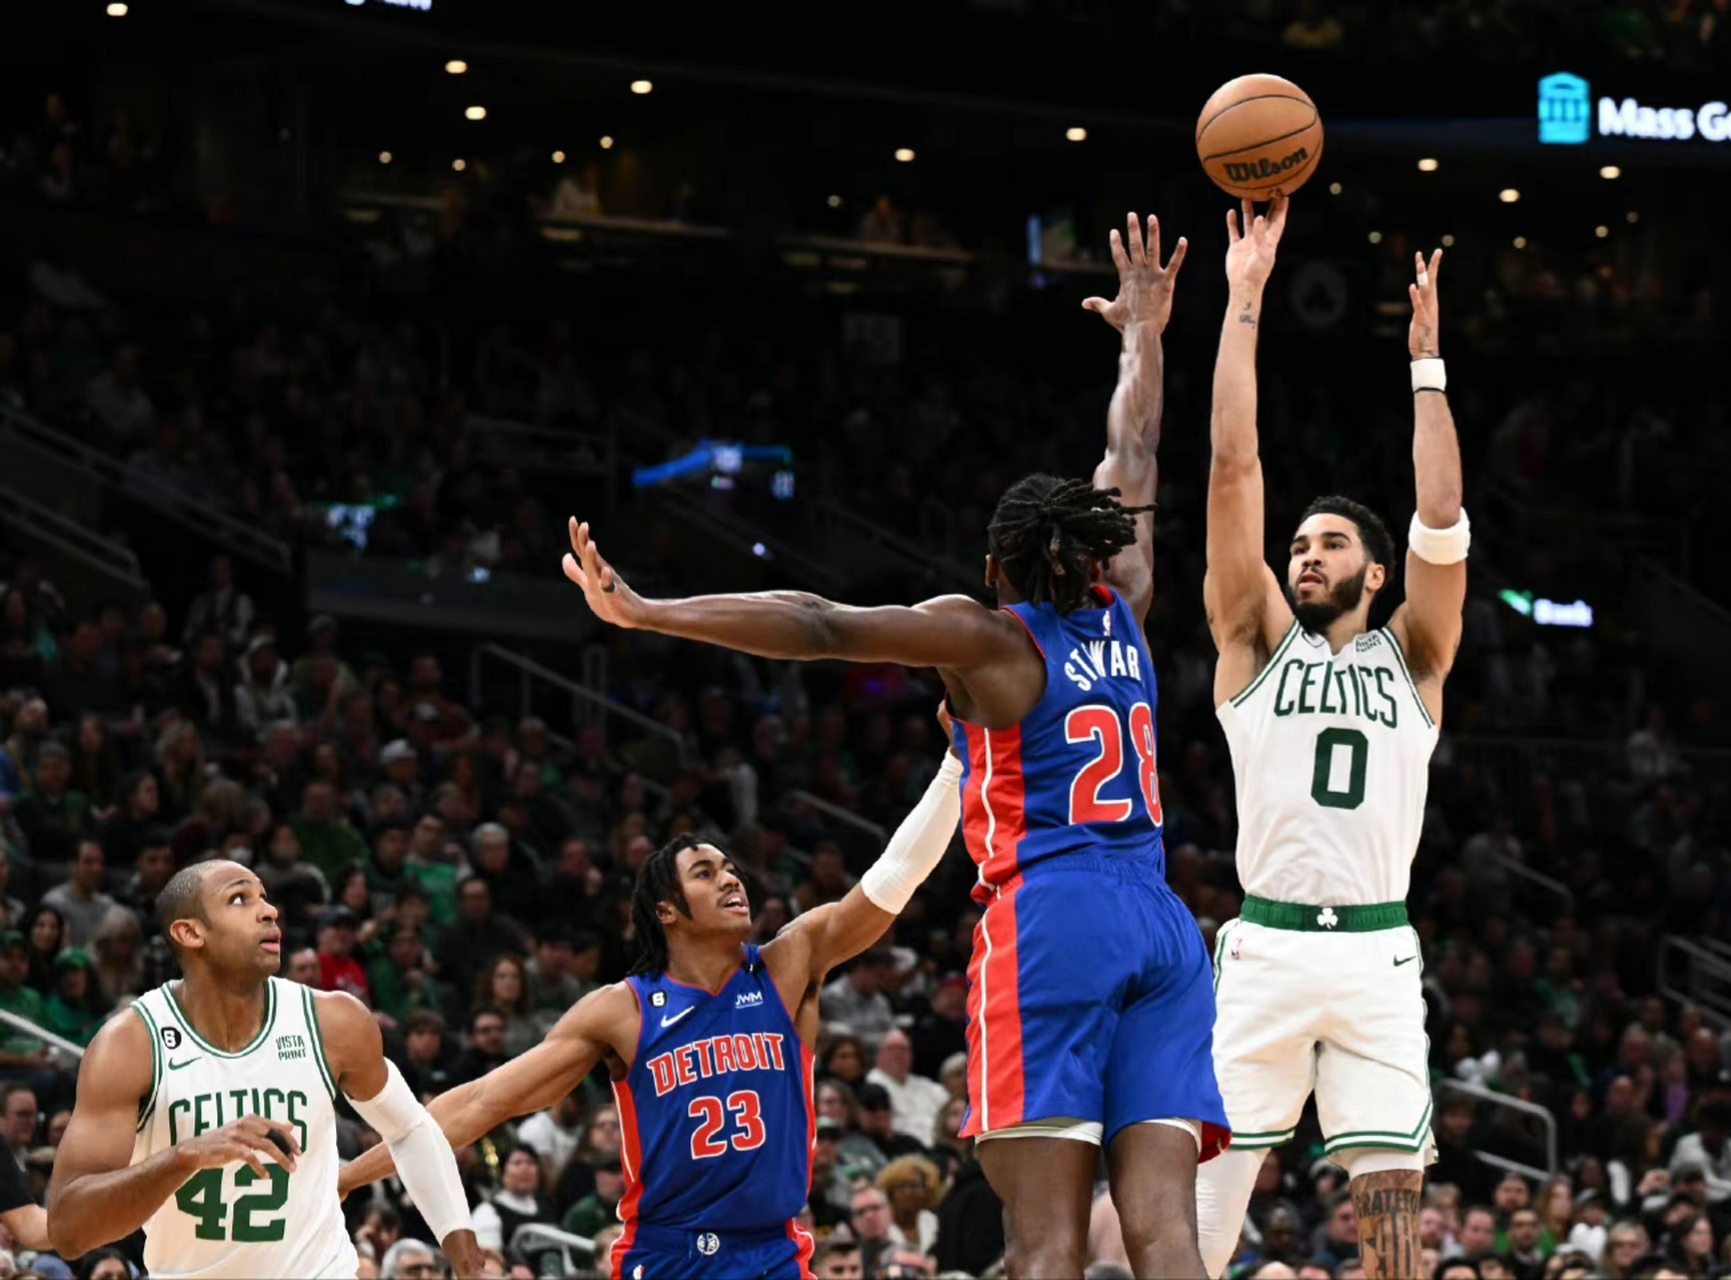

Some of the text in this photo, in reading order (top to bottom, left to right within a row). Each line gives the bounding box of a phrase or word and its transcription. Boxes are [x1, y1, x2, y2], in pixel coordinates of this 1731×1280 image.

[1598, 97, 1731, 141] Mass G
[1223, 147, 1308, 182] Wilson
[1064, 640, 1143, 692] STWAR
[1274, 658, 1397, 729] CELTICS
[1064, 702, 1163, 827] 28
[1311, 727, 1369, 810] 0
[735, 990, 763, 1007] JWM
[275, 1035, 305, 1050] VISTA
[278, 1048, 307, 1061] PRINT
[646, 1032, 785, 1097] DETROIT
[688, 1090, 766, 1160] 23
[174, 1163, 290, 1242] 42
